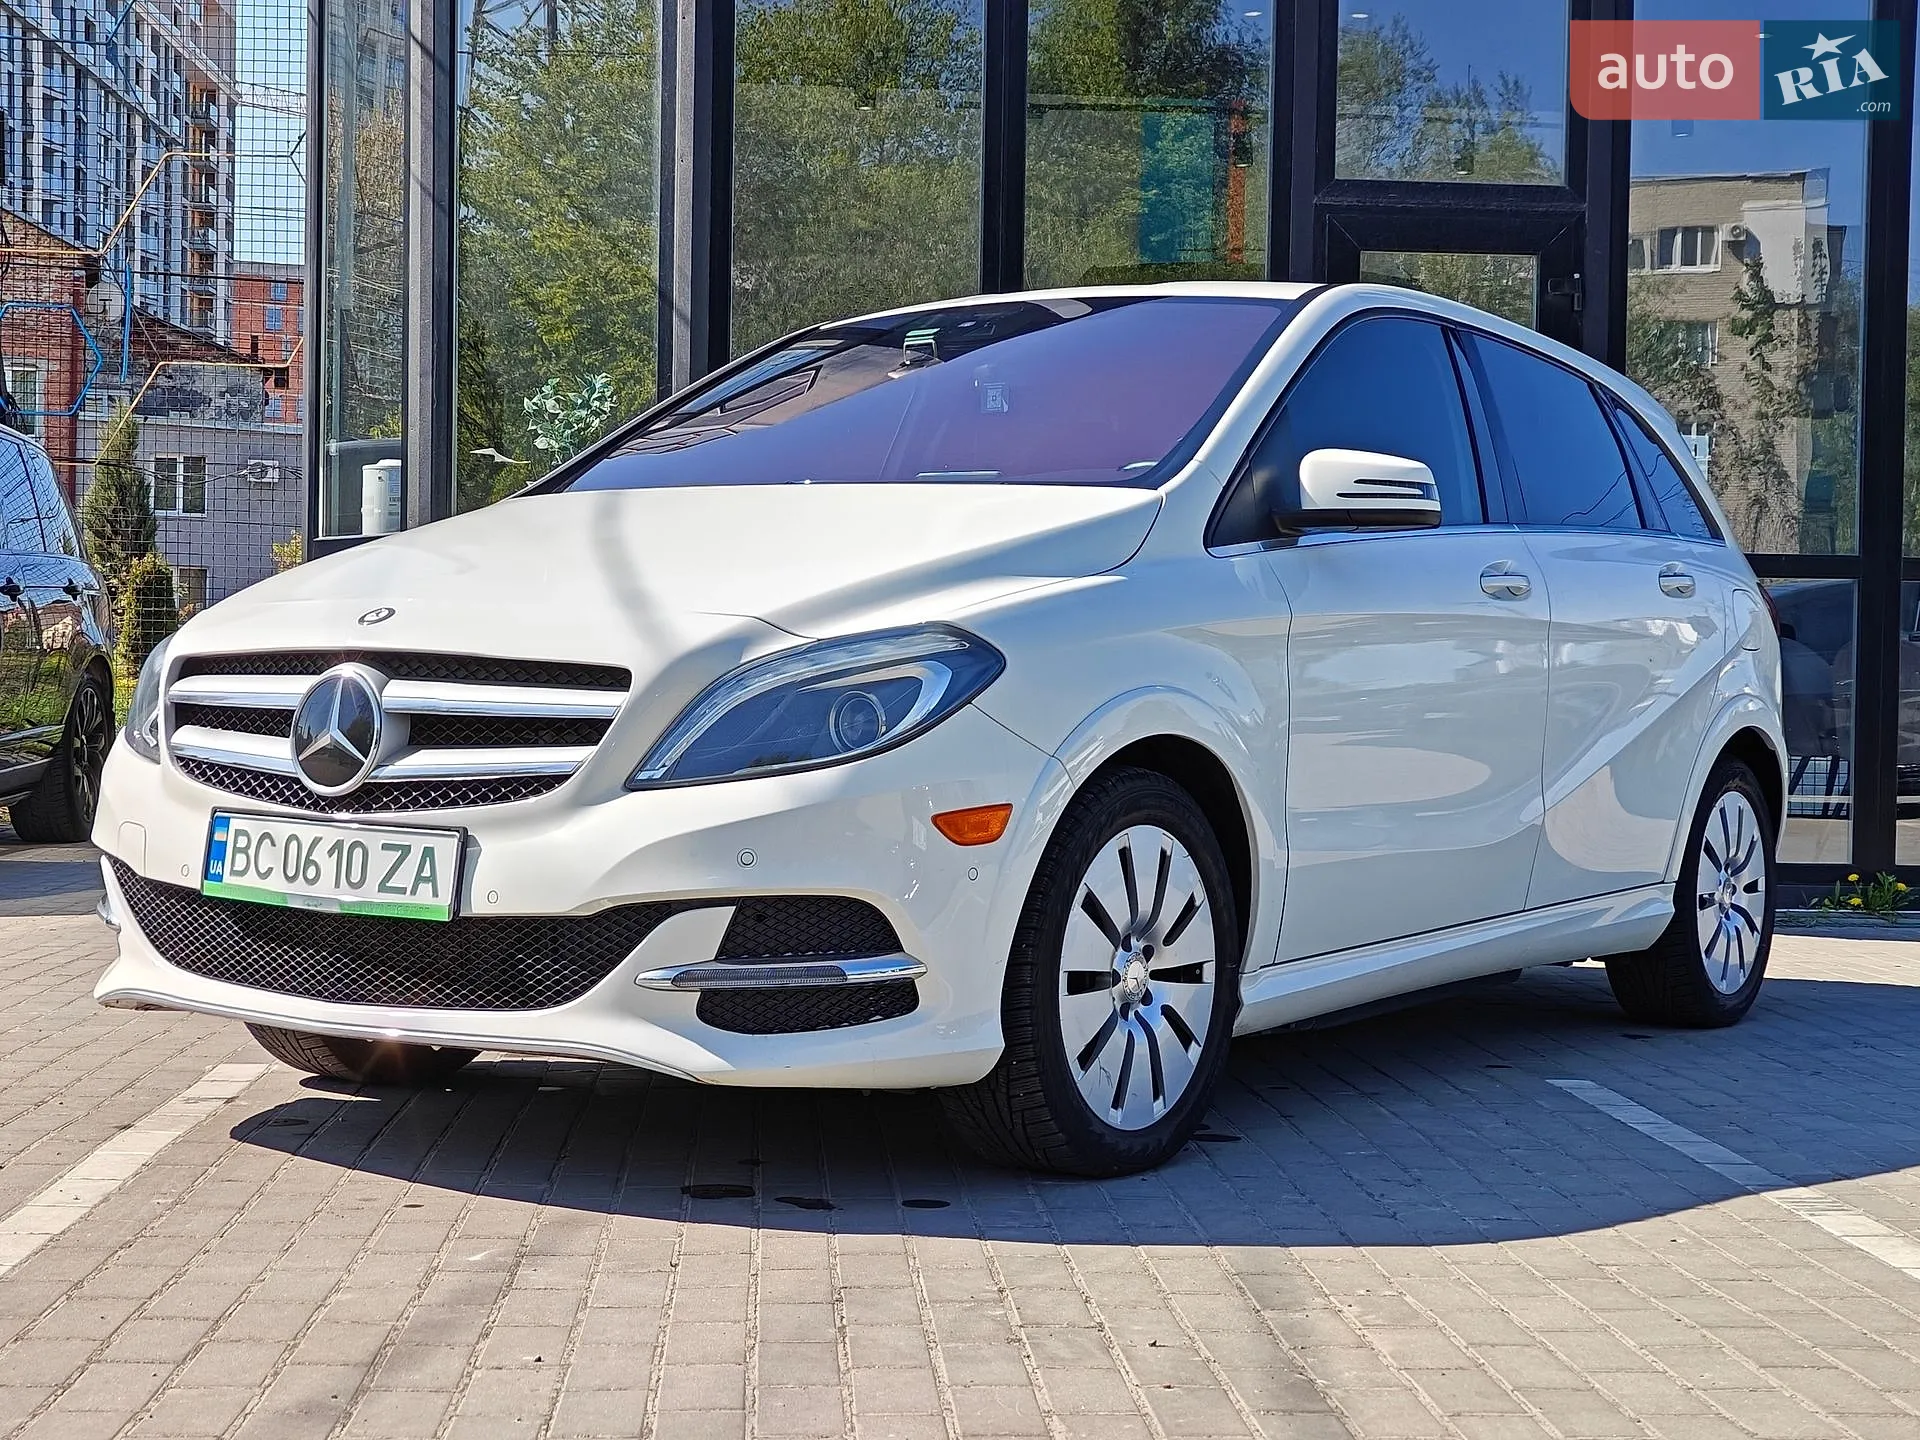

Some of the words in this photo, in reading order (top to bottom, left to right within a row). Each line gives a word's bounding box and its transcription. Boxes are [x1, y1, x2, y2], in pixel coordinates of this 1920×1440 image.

[209, 859, 223, 875] UA
[229, 828, 277, 881] BC
[282, 833, 369, 888] 0610
[378, 842, 440, 898] ZA
